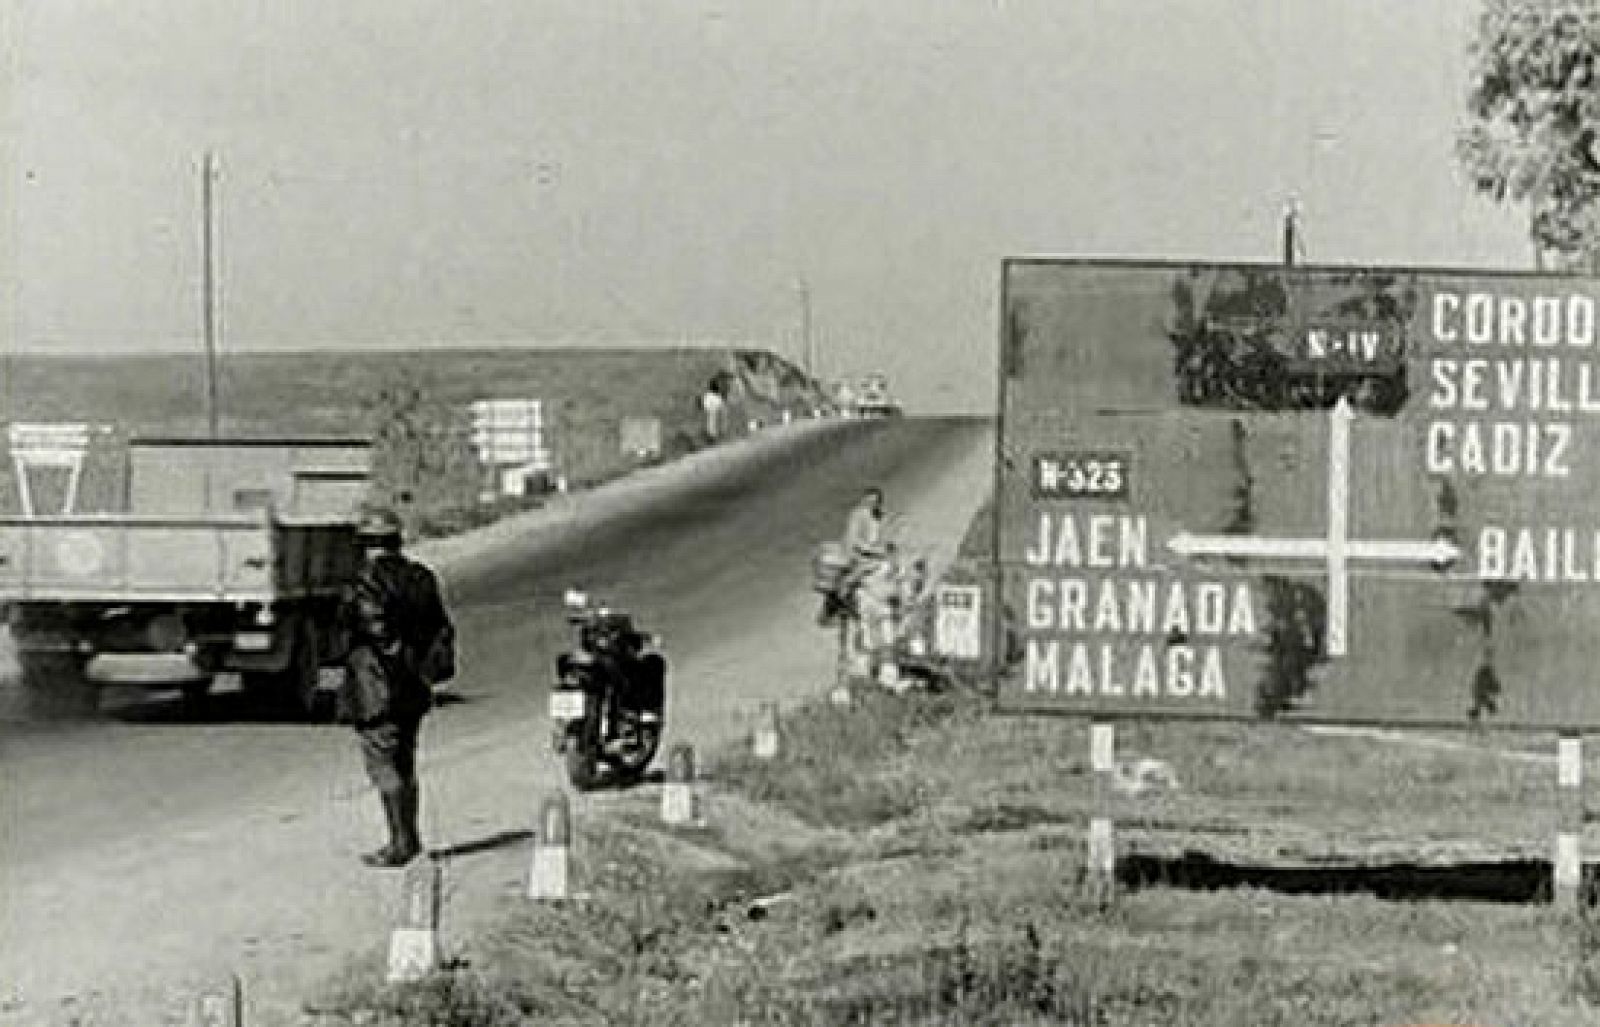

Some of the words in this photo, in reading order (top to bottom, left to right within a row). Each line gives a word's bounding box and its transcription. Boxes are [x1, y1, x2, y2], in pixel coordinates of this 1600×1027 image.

[1432, 357, 1600, 412] SEVILL
[1427, 421, 1571, 475] CADIZ
[1026, 512, 1147, 567] JAEN
[1478, 527, 1600, 580] BAIL
[1027, 579, 1255, 633] GRANADA
[1025, 640, 1226, 698] MALAGA
